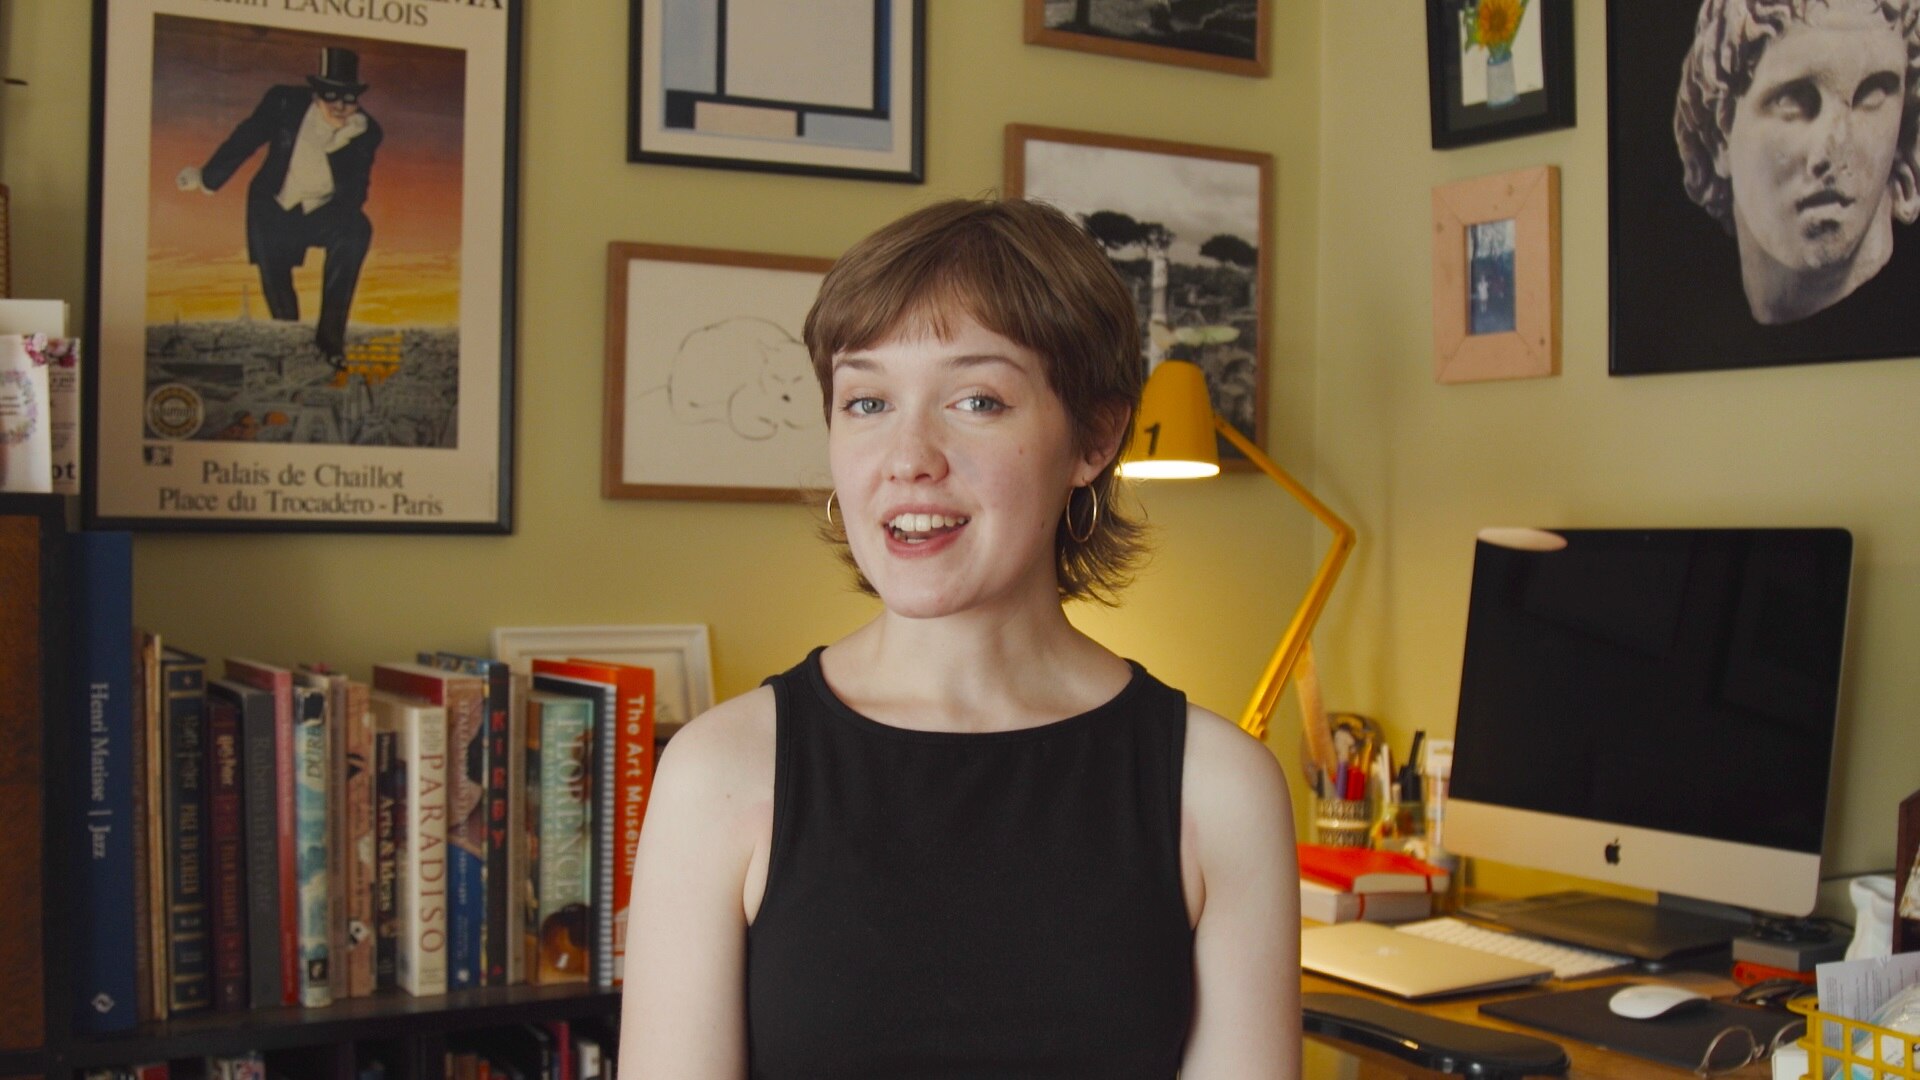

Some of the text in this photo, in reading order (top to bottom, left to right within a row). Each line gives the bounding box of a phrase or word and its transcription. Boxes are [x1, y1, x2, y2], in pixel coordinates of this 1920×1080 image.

[1144, 422, 1161, 457] 1
[202, 460, 405, 489] Palais de Chaillot
[158, 488, 219, 512] Place
[227, 489, 256, 512] du
[265, 489, 375, 514] Trocadéro
[392, 493, 444, 515] Paris
[90, 682, 110, 732] Henri
[90, 737, 110, 801] Matisse
[624, 694, 645, 876] The Art Museum
[380, 796, 394, 837] Arts
[555, 718, 585, 899] FLORENCE
[87, 824, 111, 859] Jazz
[420, 754, 446, 953] PARADISO
[380, 860, 395, 912] Ideas
